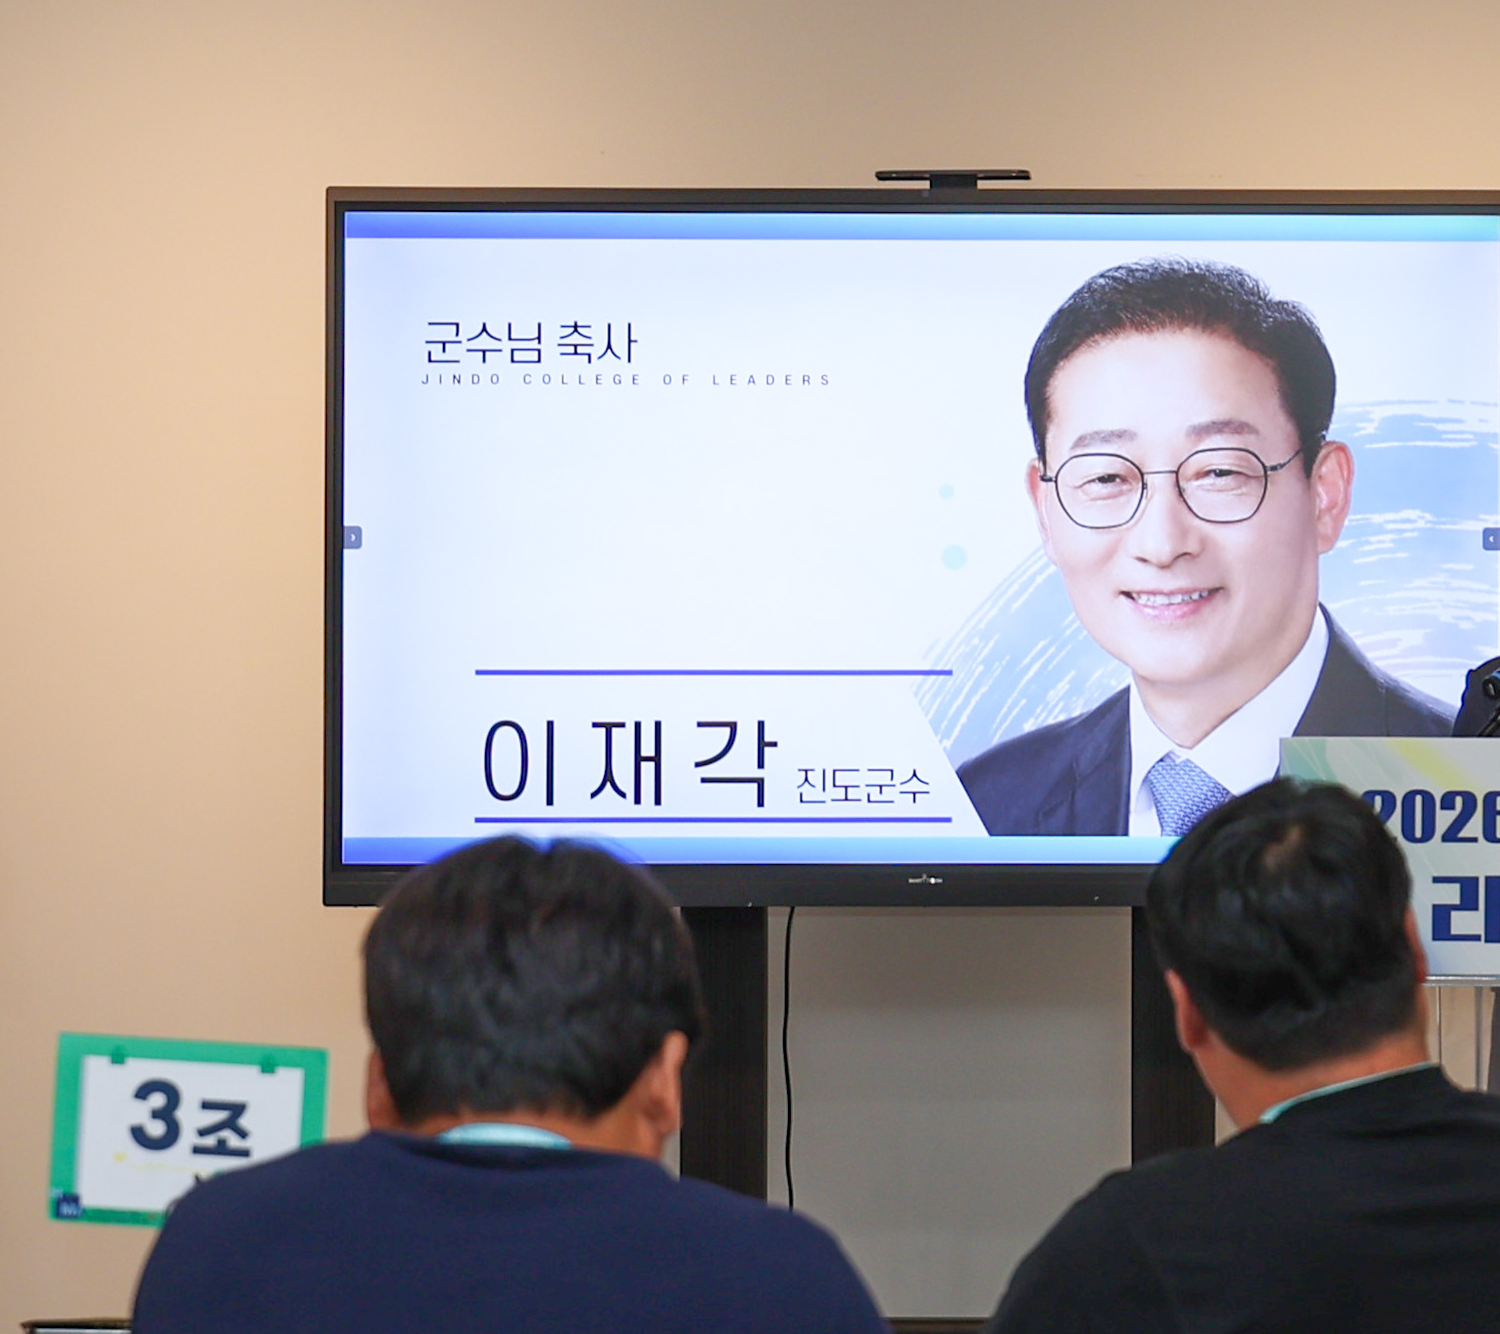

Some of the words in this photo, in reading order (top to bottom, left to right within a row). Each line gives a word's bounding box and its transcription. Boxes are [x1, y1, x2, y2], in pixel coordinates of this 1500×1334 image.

[424, 321, 543, 364] 군수님
[556, 320, 639, 364] 축사
[421, 373, 501, 386] JINDO
[522, 373, 641, 386] COLLEGE
[663, 373, 691, 386] OF
[712, 373, 831, 386] LEADERS
[796, 768, 931, 804] 진도군수
[129, 1078, 252, 1157] 3조
